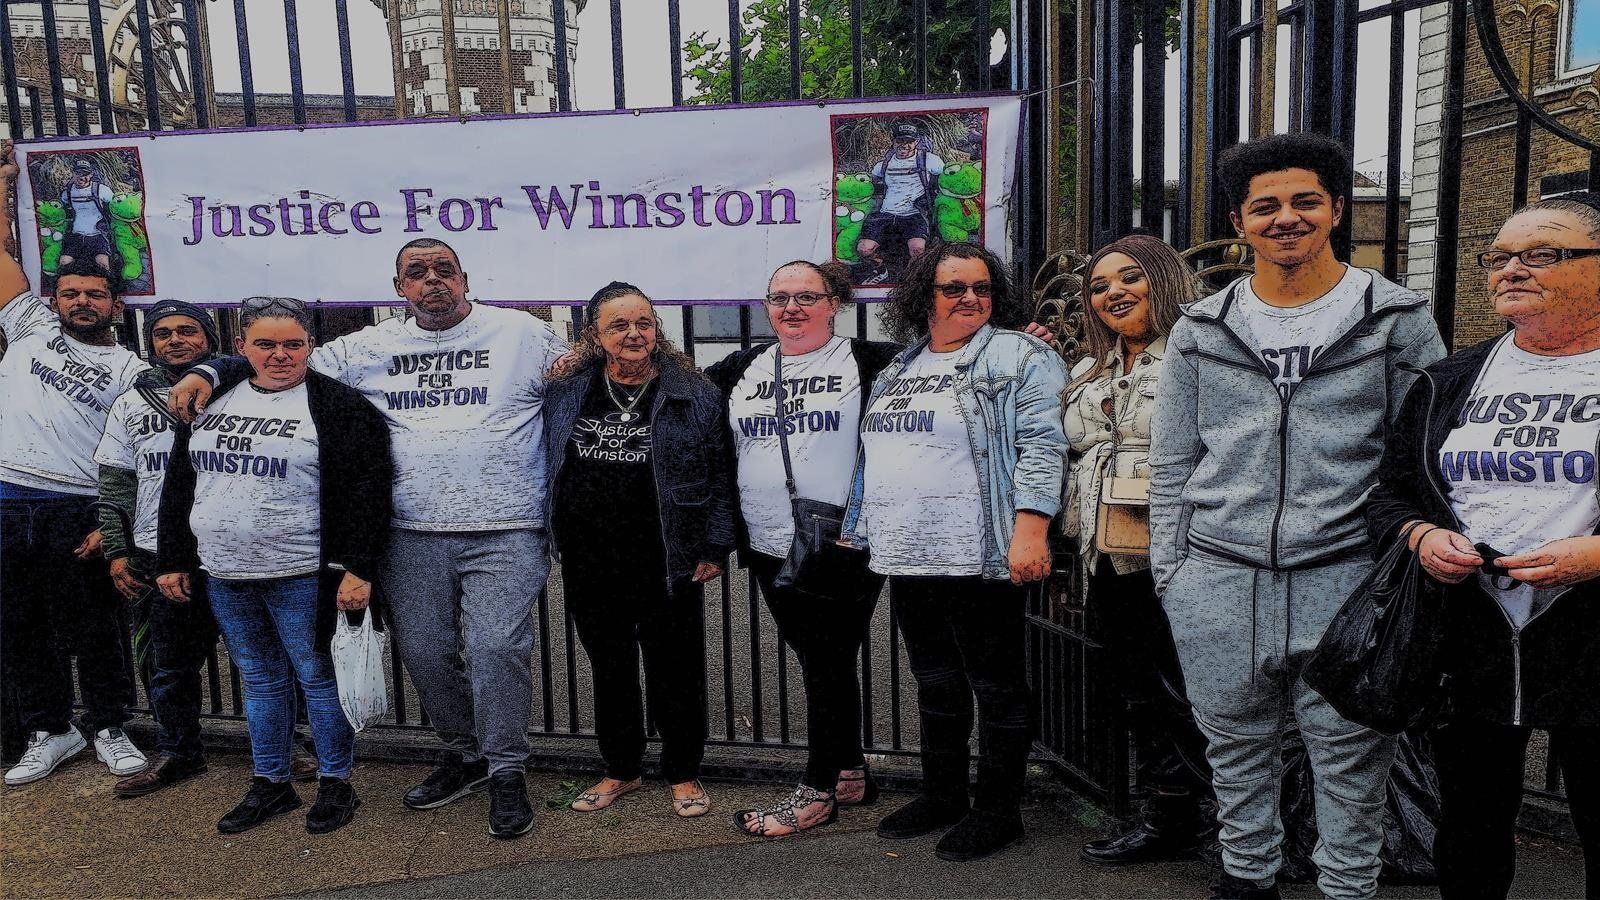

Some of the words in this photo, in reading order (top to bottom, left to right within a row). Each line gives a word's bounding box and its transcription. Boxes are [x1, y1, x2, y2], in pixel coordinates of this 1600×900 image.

[183, 190, 382, 245] Justice
[400, 188, 503, 232] For
[521, 180, 801, 230] Winston
[61, 359, 82, 378] FO
[387, 349, 490, 377] JUSTICE
[1260, 344, 1324, 380] STI
[417, 373, 453, 389] FOR
[744, 374, 843, 401] JUSTICE
[881, 374, 953, 398] USTICE
[384, 386, 488, 410] WINSTON
[782, 397, 805, 416] OR
[884, 397, 912, 411] FOR
[192, 413, 301, 438] JUSTICE
[576, 419, 647, 436] Justice
[737, 410, 841, 437] WINSTON
[215, 434, 253, 452] FOR
[597, 433, 627, 449] For
[1493, 425, 1560, 448] FOR
[576, 443, 647, 462] Winston
